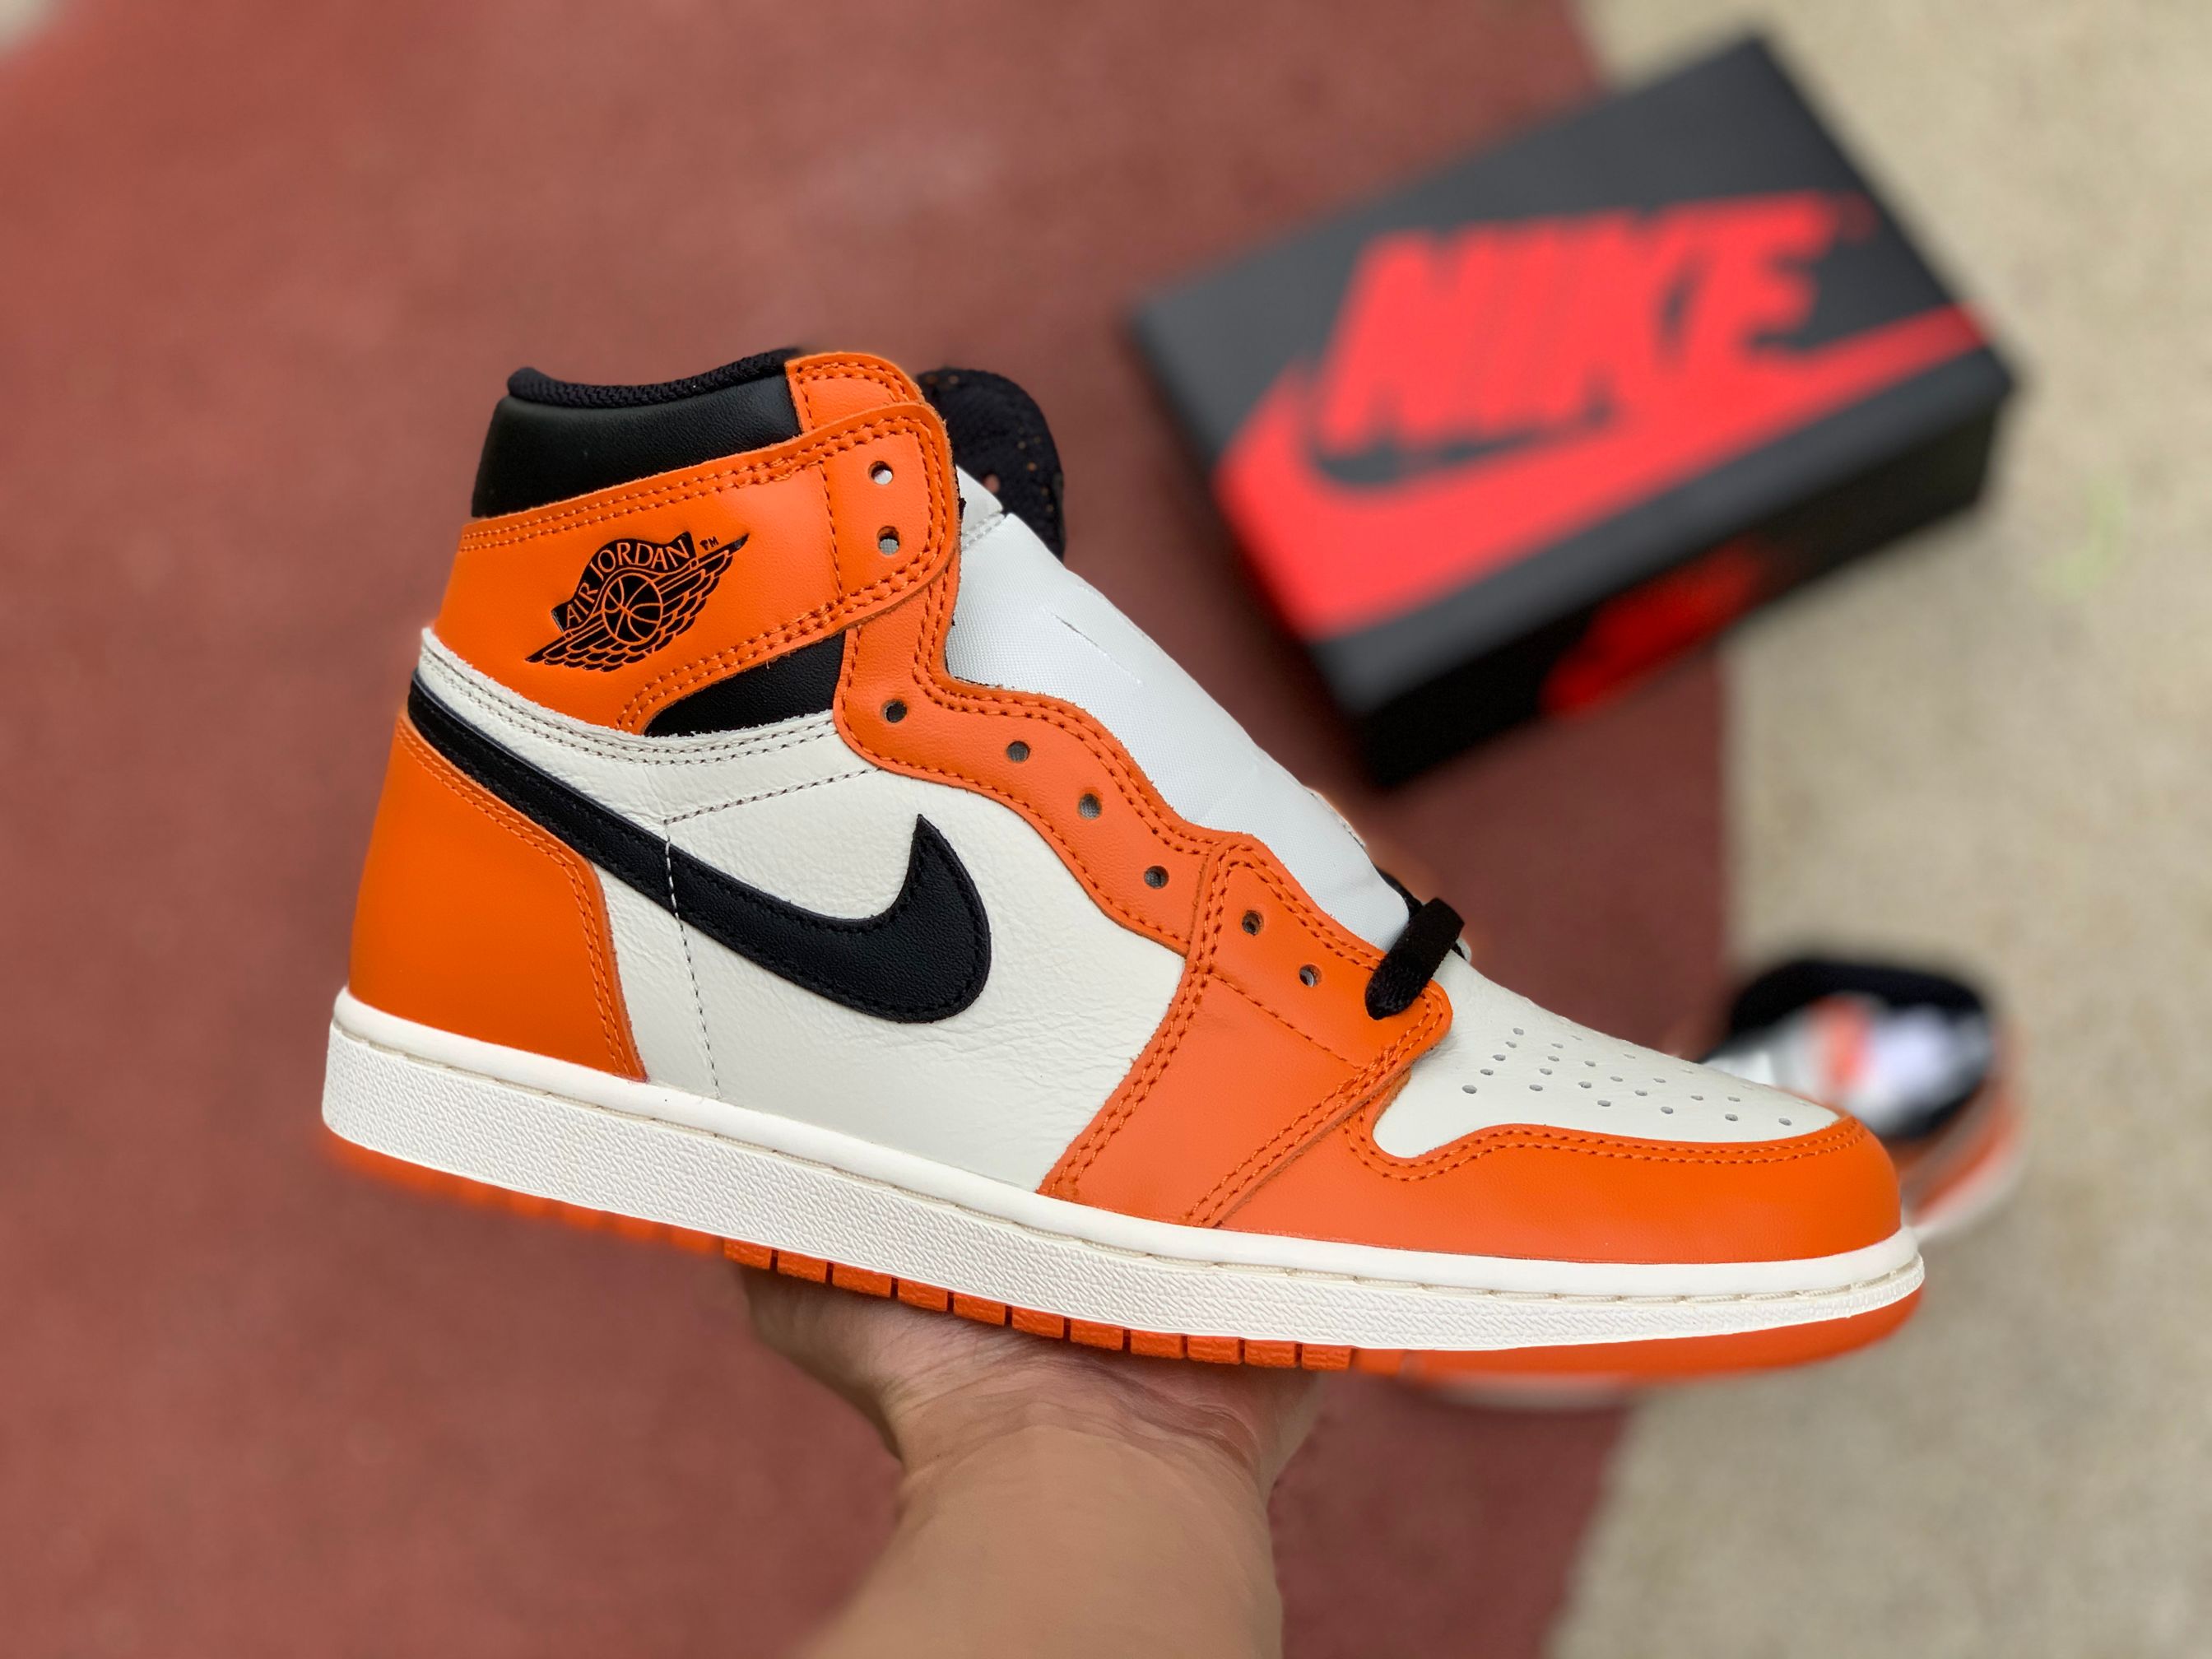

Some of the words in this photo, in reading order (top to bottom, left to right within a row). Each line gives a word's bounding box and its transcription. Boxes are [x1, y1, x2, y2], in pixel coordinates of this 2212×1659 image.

[1321, 194, 1833, 449] NIKE
[565, 583, 599, 627] AIR
[590, 539, 690, 579] JORDAN
